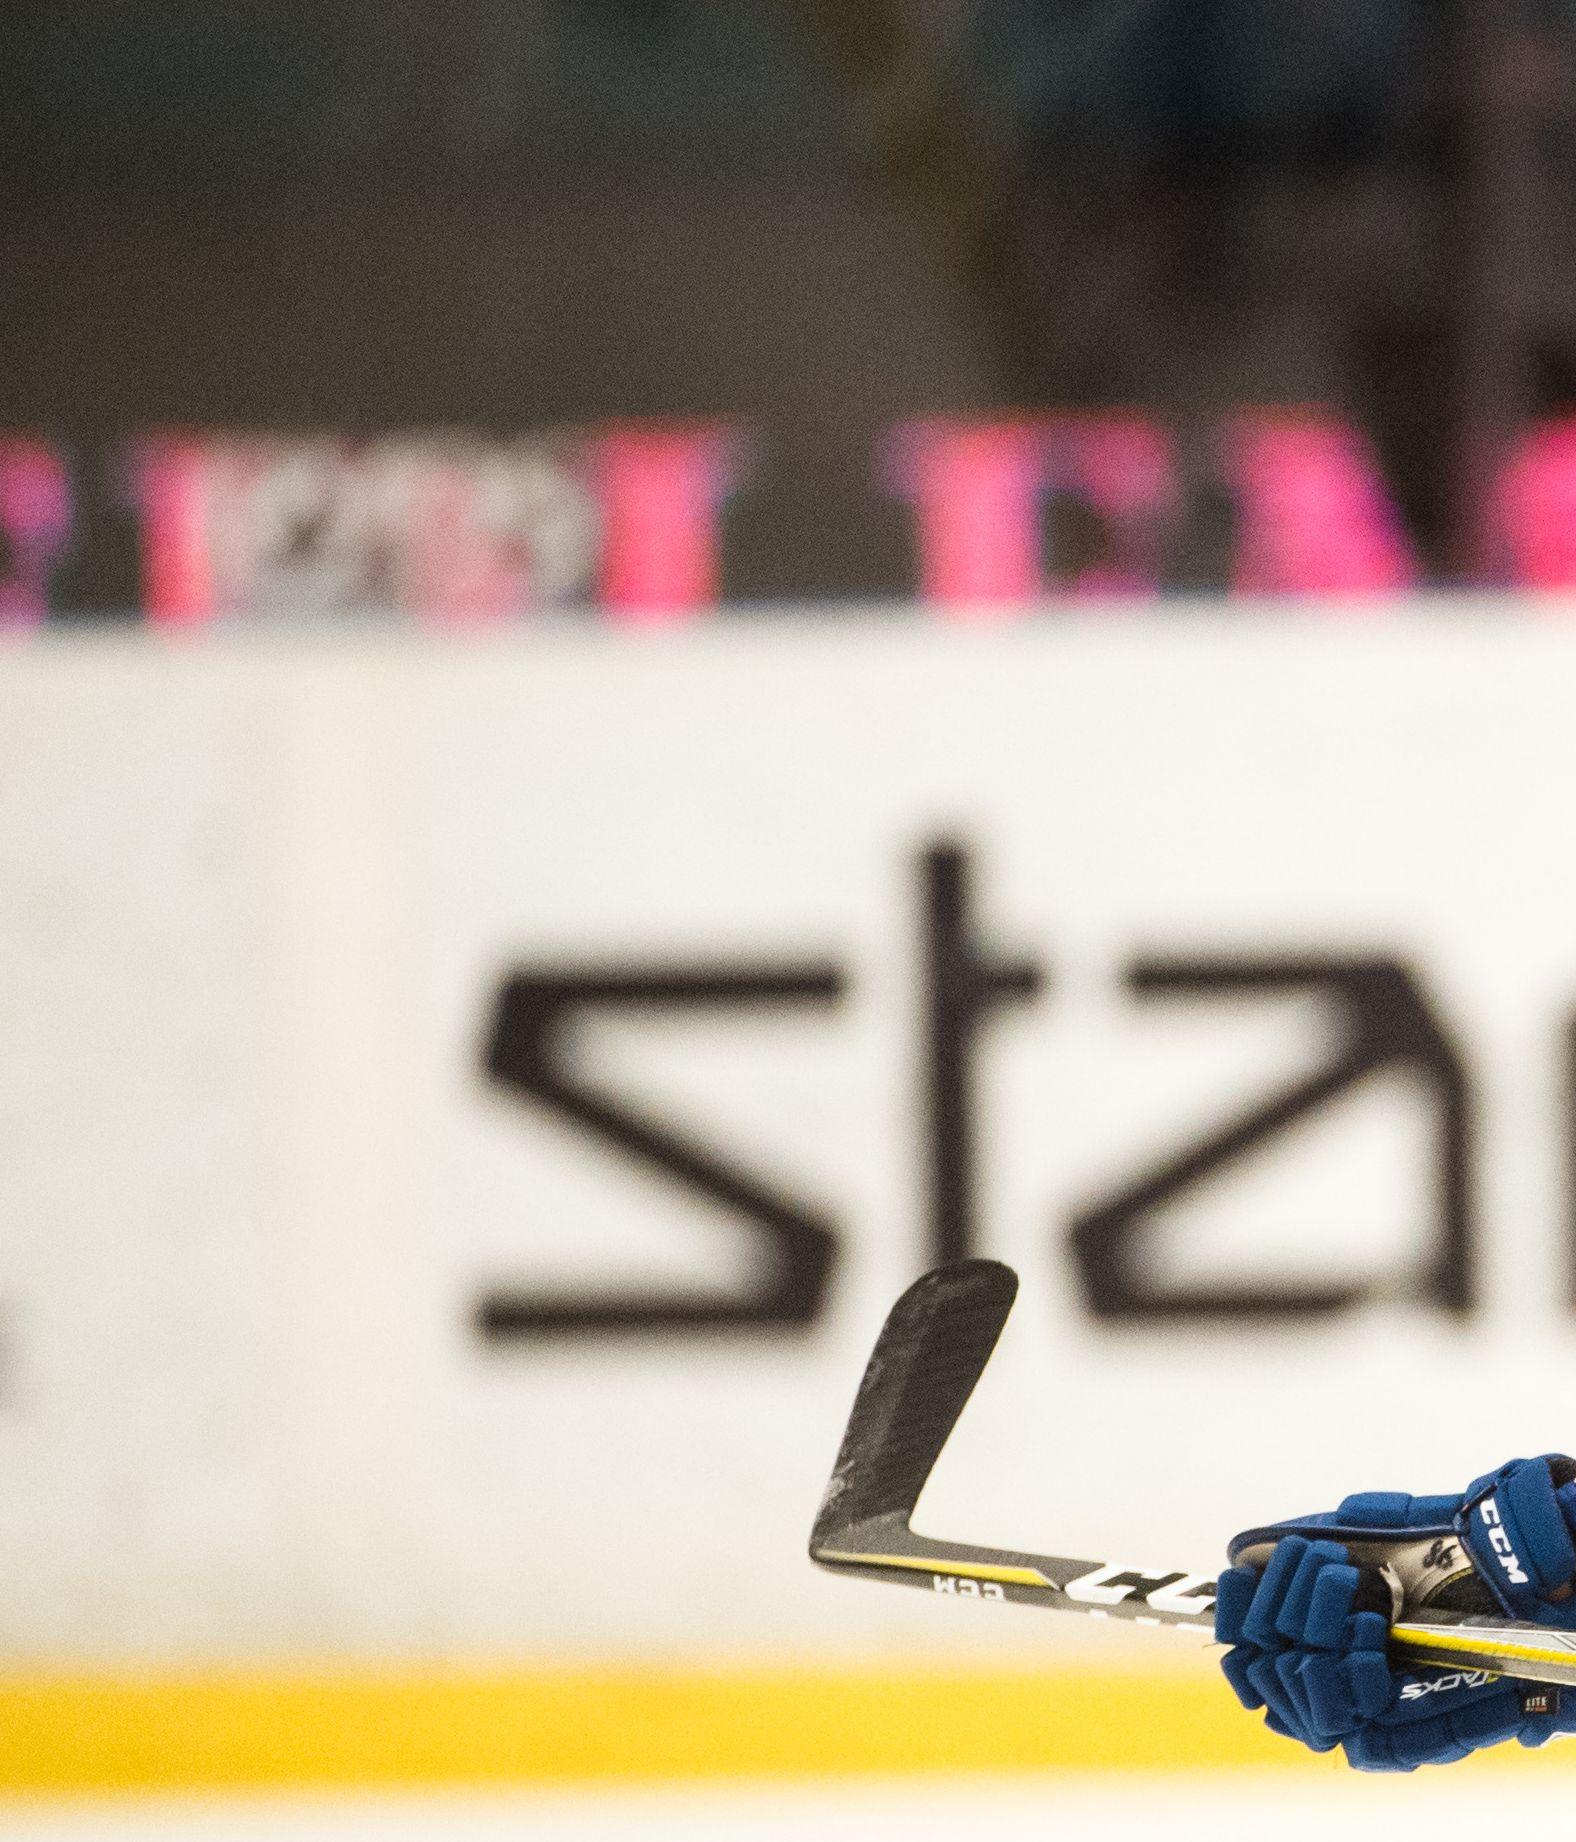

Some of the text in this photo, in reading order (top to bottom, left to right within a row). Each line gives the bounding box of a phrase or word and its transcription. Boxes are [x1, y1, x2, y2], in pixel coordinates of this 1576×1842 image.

[1479, 1497, 1530, 1585] CCM
[1064, 1561, 1218, 1615] CC
[1400, 1669, 1492, 1701] TACKS
